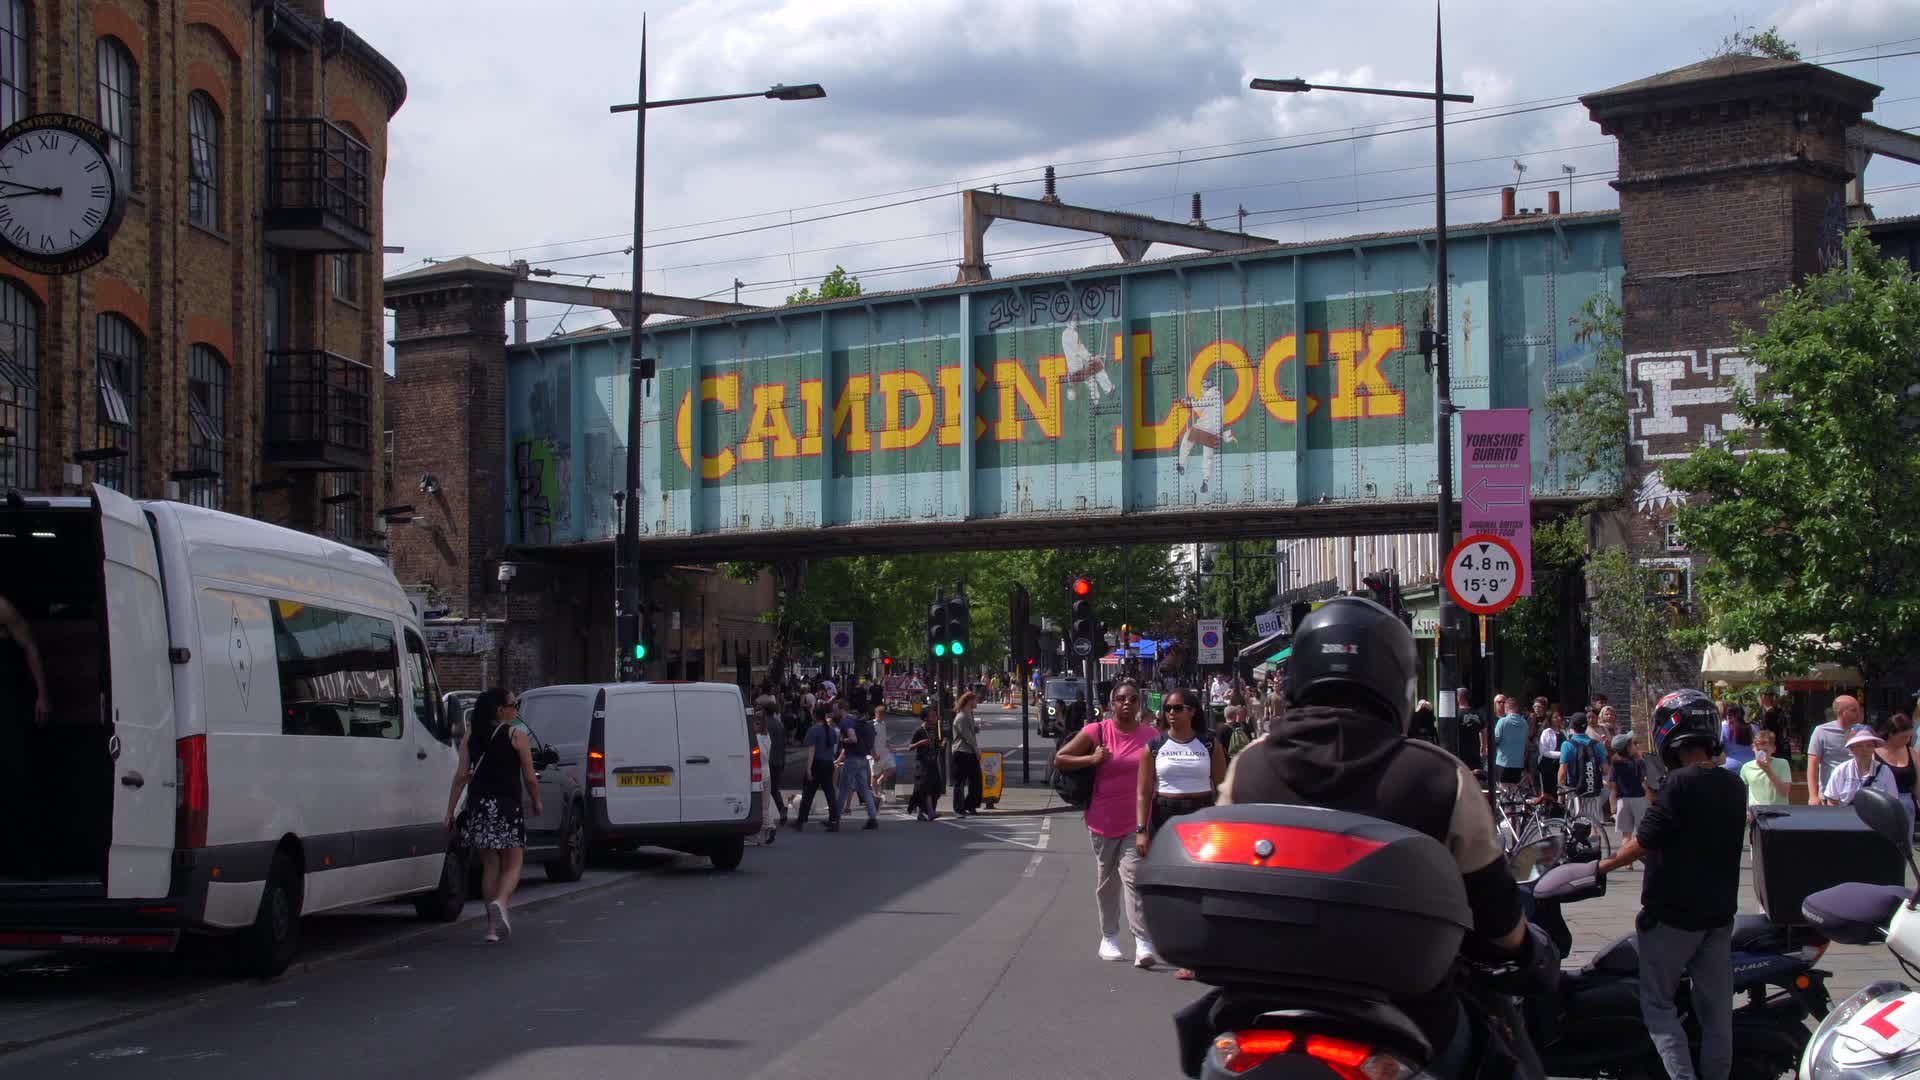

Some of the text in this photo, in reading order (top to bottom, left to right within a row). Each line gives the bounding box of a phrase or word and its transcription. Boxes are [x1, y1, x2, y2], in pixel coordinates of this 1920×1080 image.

[6, 116, 104, 139] CAMDEN LOCK
[14, 139, 33, 159] XI
[38, 135, 59, 150] XII
[84, 160, 100, 173] II
[91, 186, 105, 198] III
[40, 234, 55, 249] VI
[69, 229, 81, 244] V
[1030, 286, 1122, 324] FOOT
[676, 323, 1405, 480] CAMDEN LOCK
[1466, 433, 1525, 448] YORKSHIRE
[1472, 447, 1518, 461] BURRITO
[1460, 554, 1509, 571] 4.8 m
[1585, 761, 1594, 793] adidas
[1861, 1000, 1905, 1041] L
